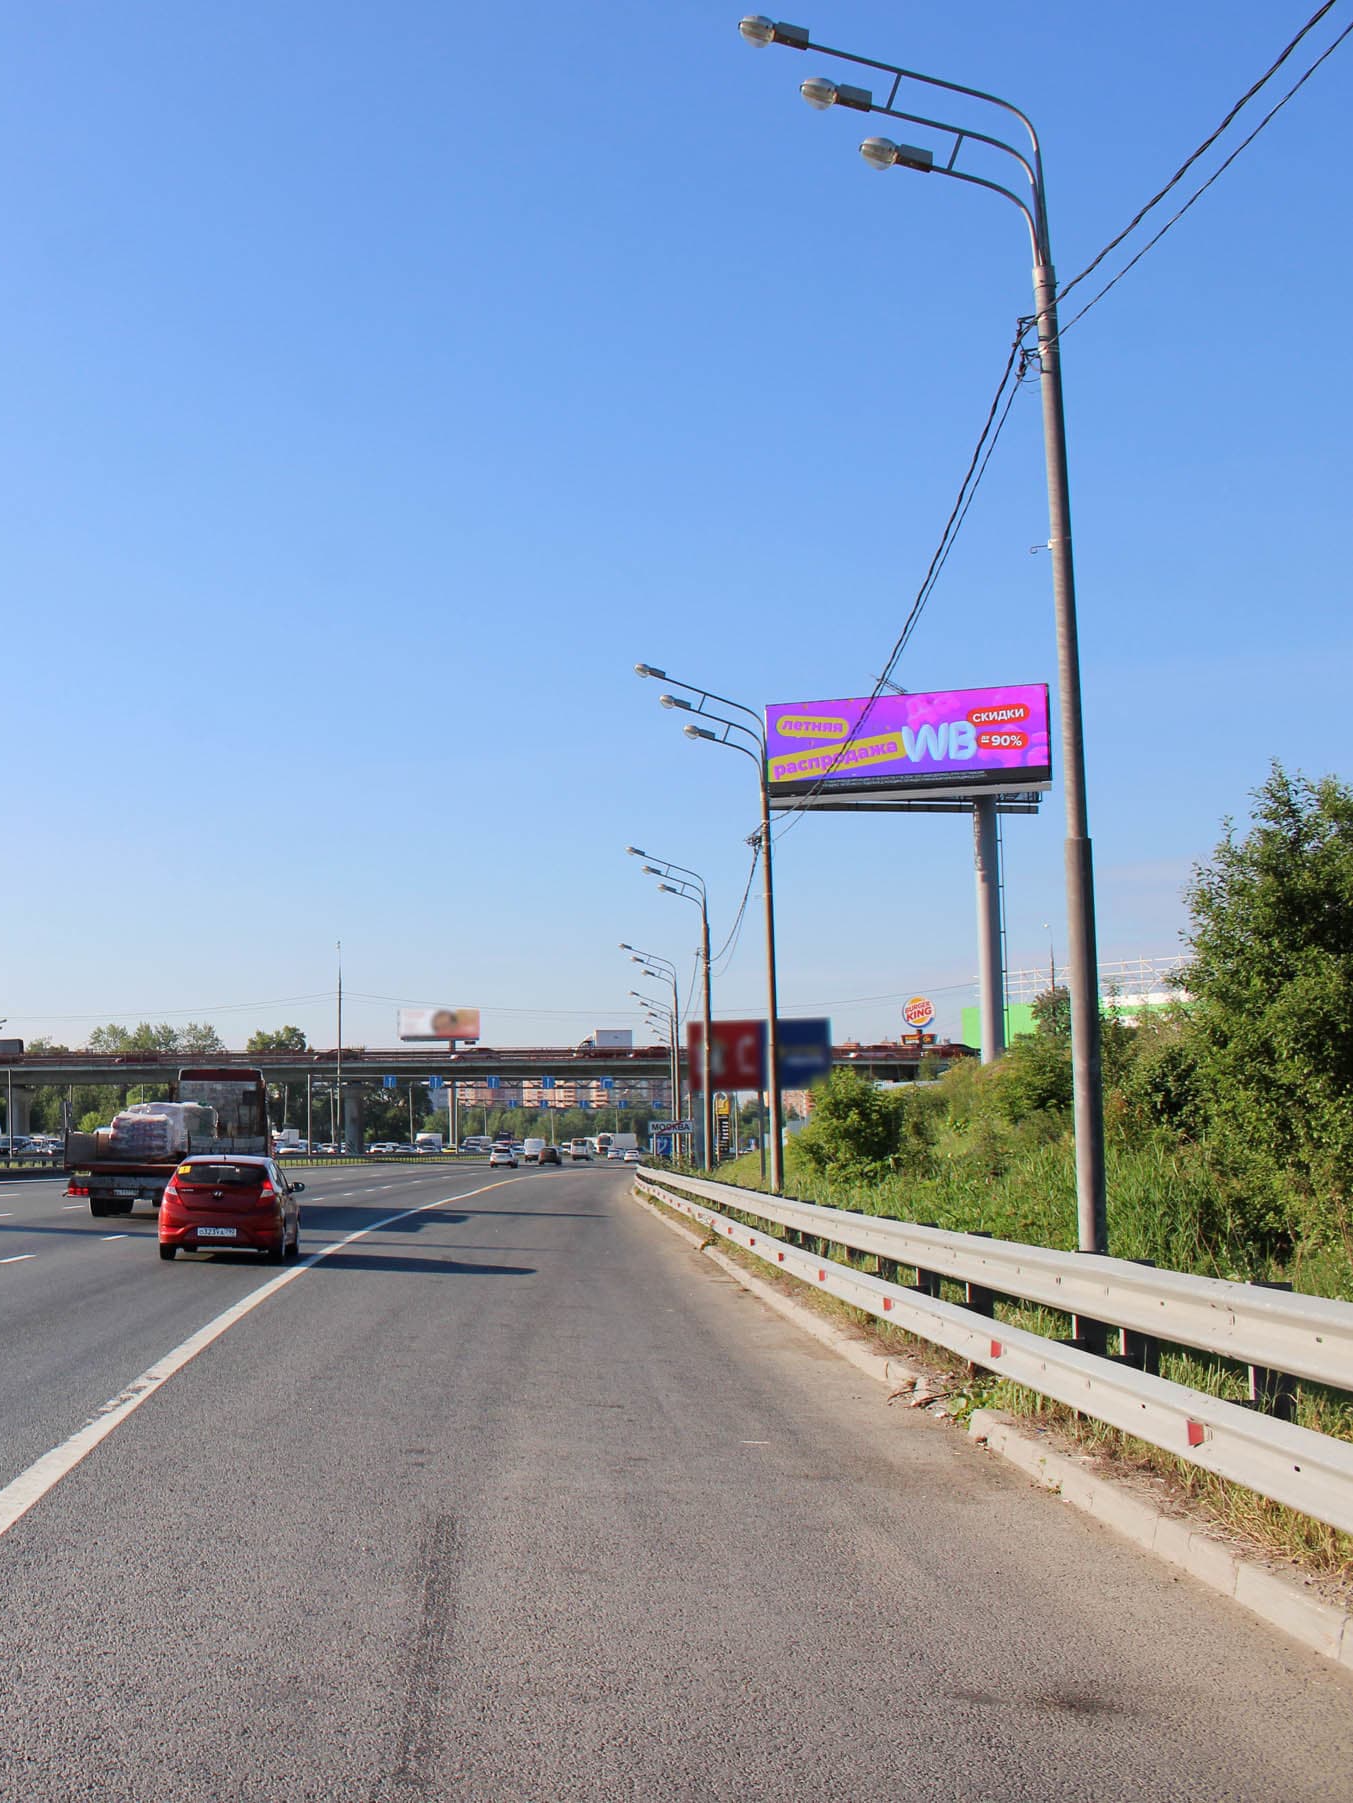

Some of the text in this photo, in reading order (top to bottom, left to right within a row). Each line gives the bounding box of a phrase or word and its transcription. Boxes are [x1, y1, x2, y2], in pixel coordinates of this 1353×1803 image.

[972, 708, 1024, 722] СКИДКИ
[782, 721, 843, 733] летняя
[901, 721, 977, 762] WB
[905, 1001, 931, 1013] BURGER
[906, 1007, 932, 1022] KING
[651, 1123, 690, 1131] МОСКВА
